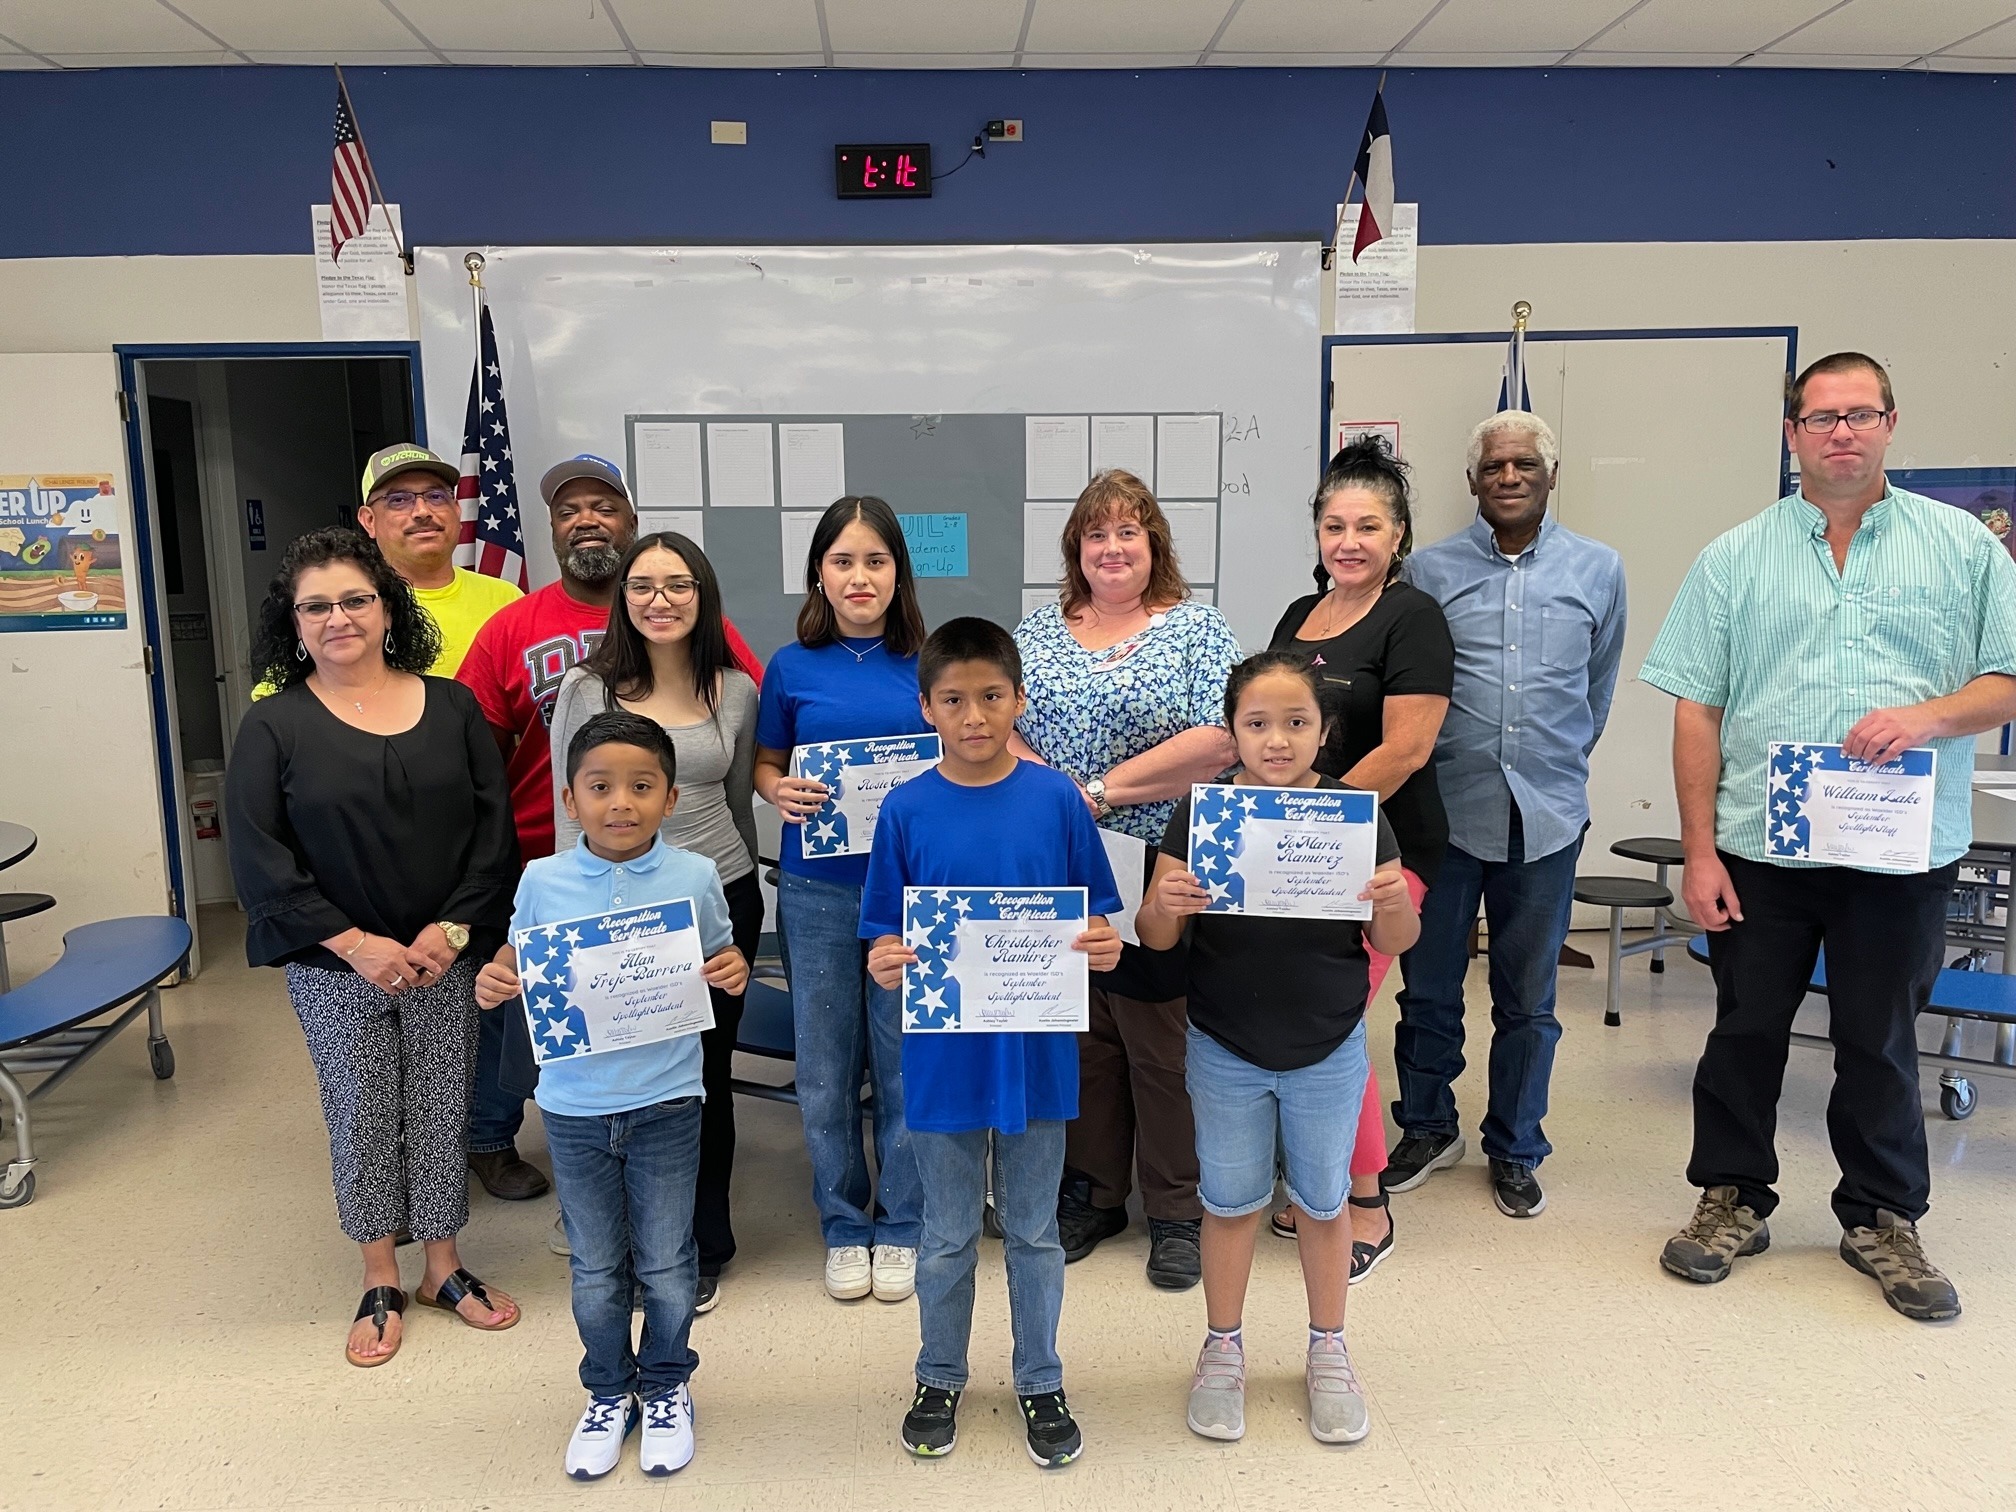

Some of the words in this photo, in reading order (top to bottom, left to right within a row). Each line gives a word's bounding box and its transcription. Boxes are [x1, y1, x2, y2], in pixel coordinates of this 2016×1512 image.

[900, 514, 944, 538] UIL
[864, 740, 916, 755] Recognition
[1274, 792, 1342, 811] Recognition
[1823, 784, 1878, 802] William
[1880, 788, 1922, 805] Lake
[1284, 806, 1346, 824] Certificate
[1848, 812, 1890, 822] September
[1838, 822, 1876, 834] Spotlight
[1876, 826, 1898, 838] Staff
[1278, 848, 1344, 870] Ramirez
[1287, 876, 1332, 886] September
[988, 892, 1054, 910] Recognition
[1272, 886, 1312, 898] Spotlight
[1311, 888, 1347, 896] Student
[598, 910, 662, 931] Recognition
[999, 906, 1058, 922] Certificate
[610, 921, 667, 942] Certificate
[984, 934, 1063, 954] Christopher
[620, 952, 655, 970] Alan
[992, 948, 1057, 970] Ramirez
[590, 962, 692, 993] Trejo-Barrera
[1002, 978, 1046, 990] September
[624, 991, 668, 1008] September
[988, 992, 1027, 1005] Spotlight
[1027, 992, 1062, 1000] Student
[612, 1006, 650, 1024] Spotlight
[650, 1000, 684, 1014] Student
